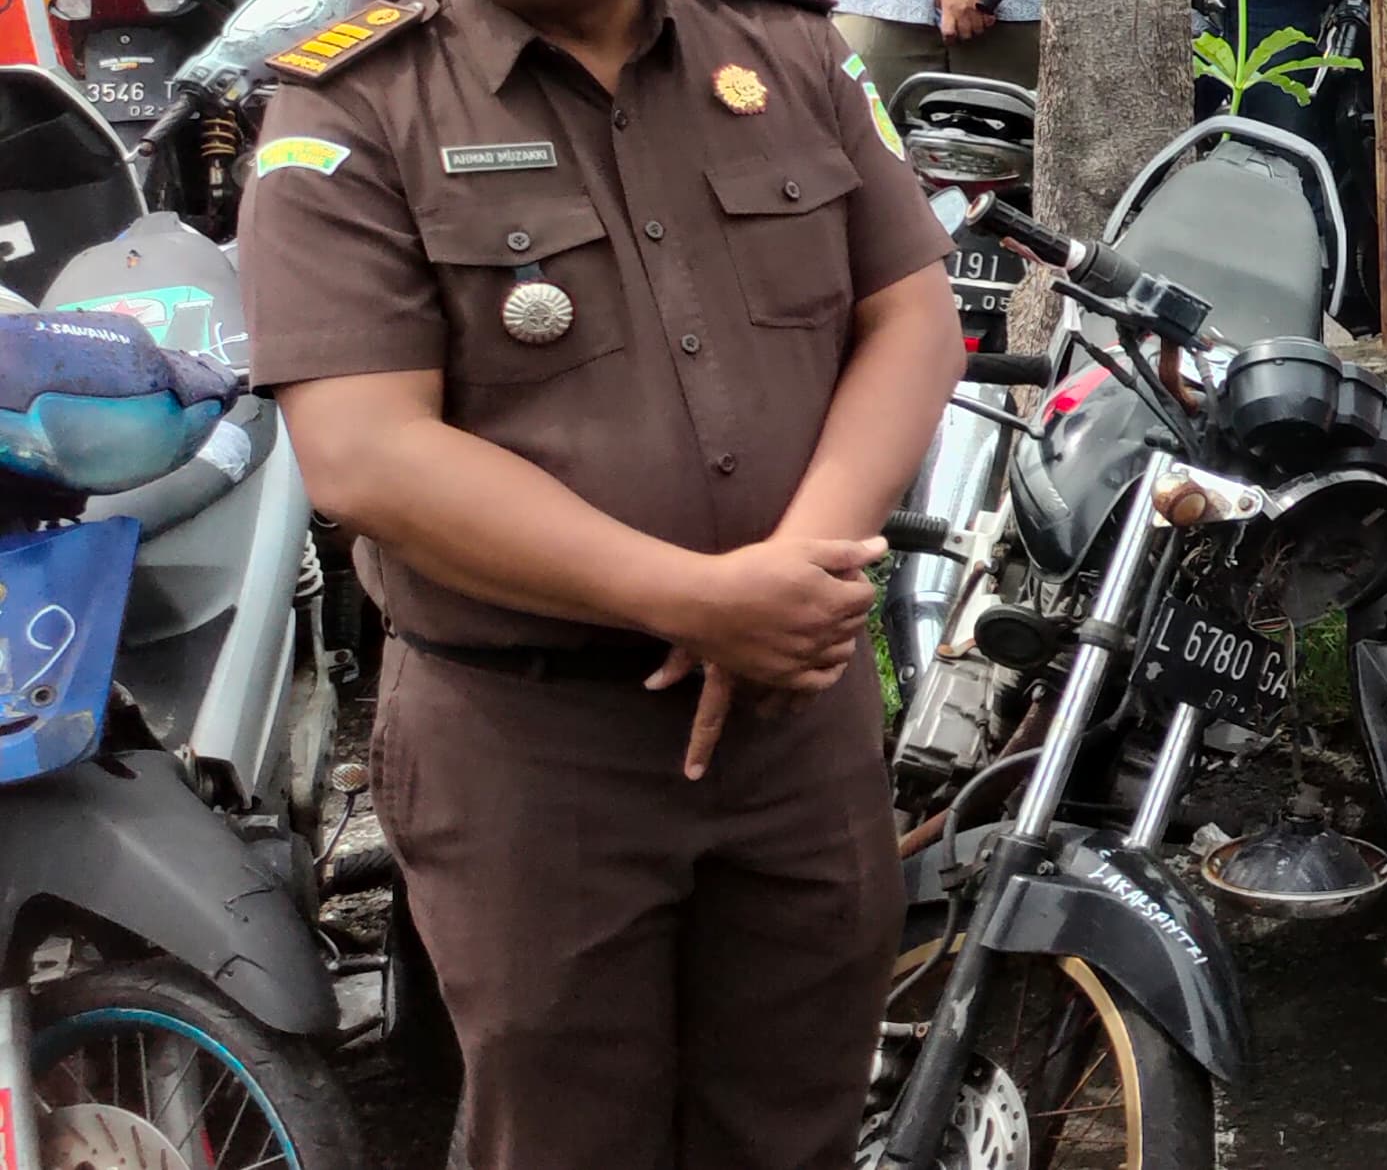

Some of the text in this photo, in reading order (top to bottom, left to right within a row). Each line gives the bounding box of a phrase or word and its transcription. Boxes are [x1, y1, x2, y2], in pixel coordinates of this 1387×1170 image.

[87, 81, 145, 104] 3546
[954, 251, 998, 282] 191
[1156, 608, 1175, 652] L
[1184, 621, 1254, 680] 6780
